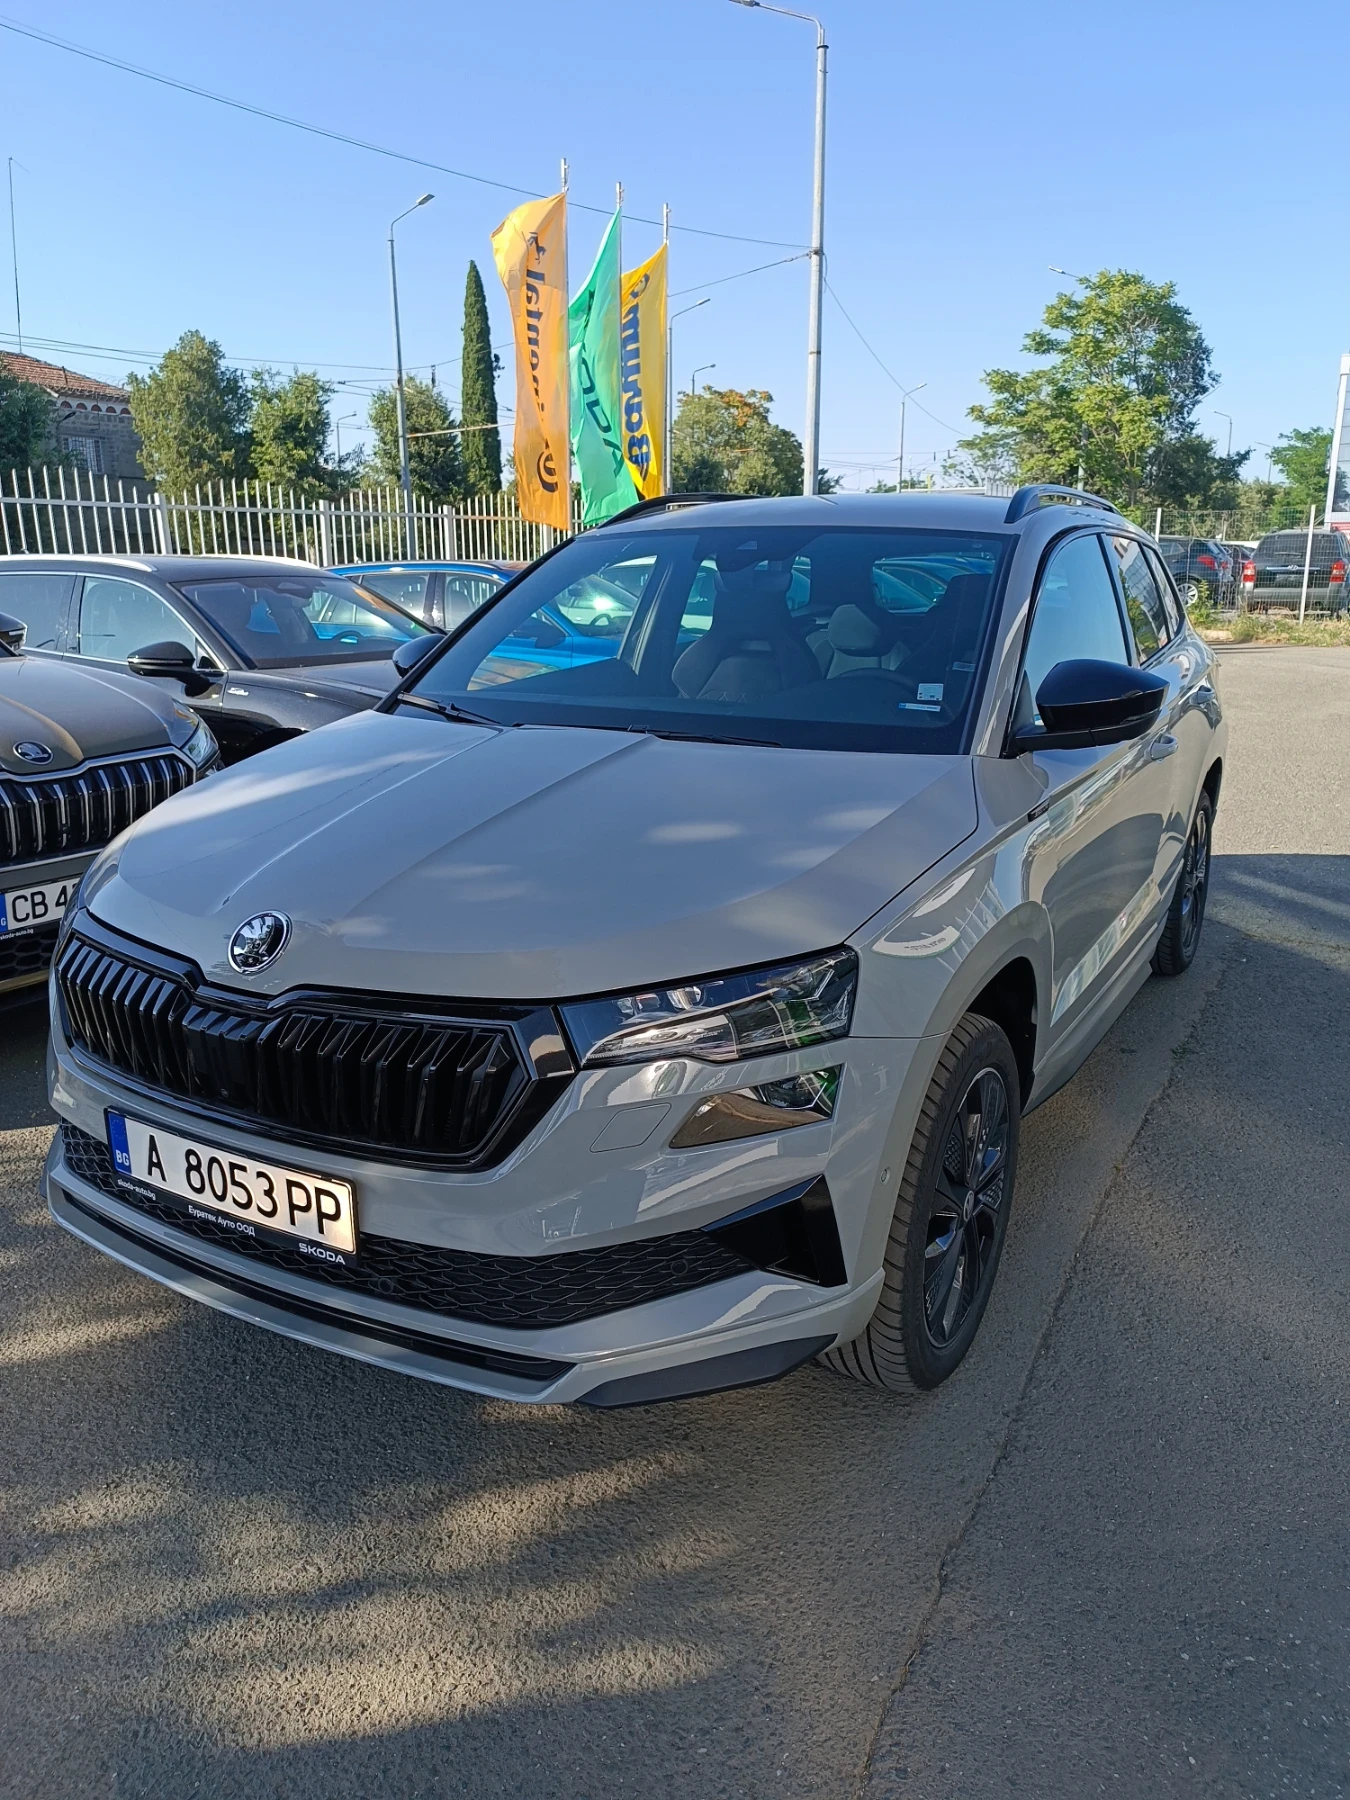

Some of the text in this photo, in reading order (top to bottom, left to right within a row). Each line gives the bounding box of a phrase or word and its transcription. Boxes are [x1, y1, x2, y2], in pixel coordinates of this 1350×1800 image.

[12, 884, 78, 923] CB 4
[116, 1149, 130, 1166] BG
[147, 1133, 168, 1182] A
[236, 1222, 256, 1238] ООД
